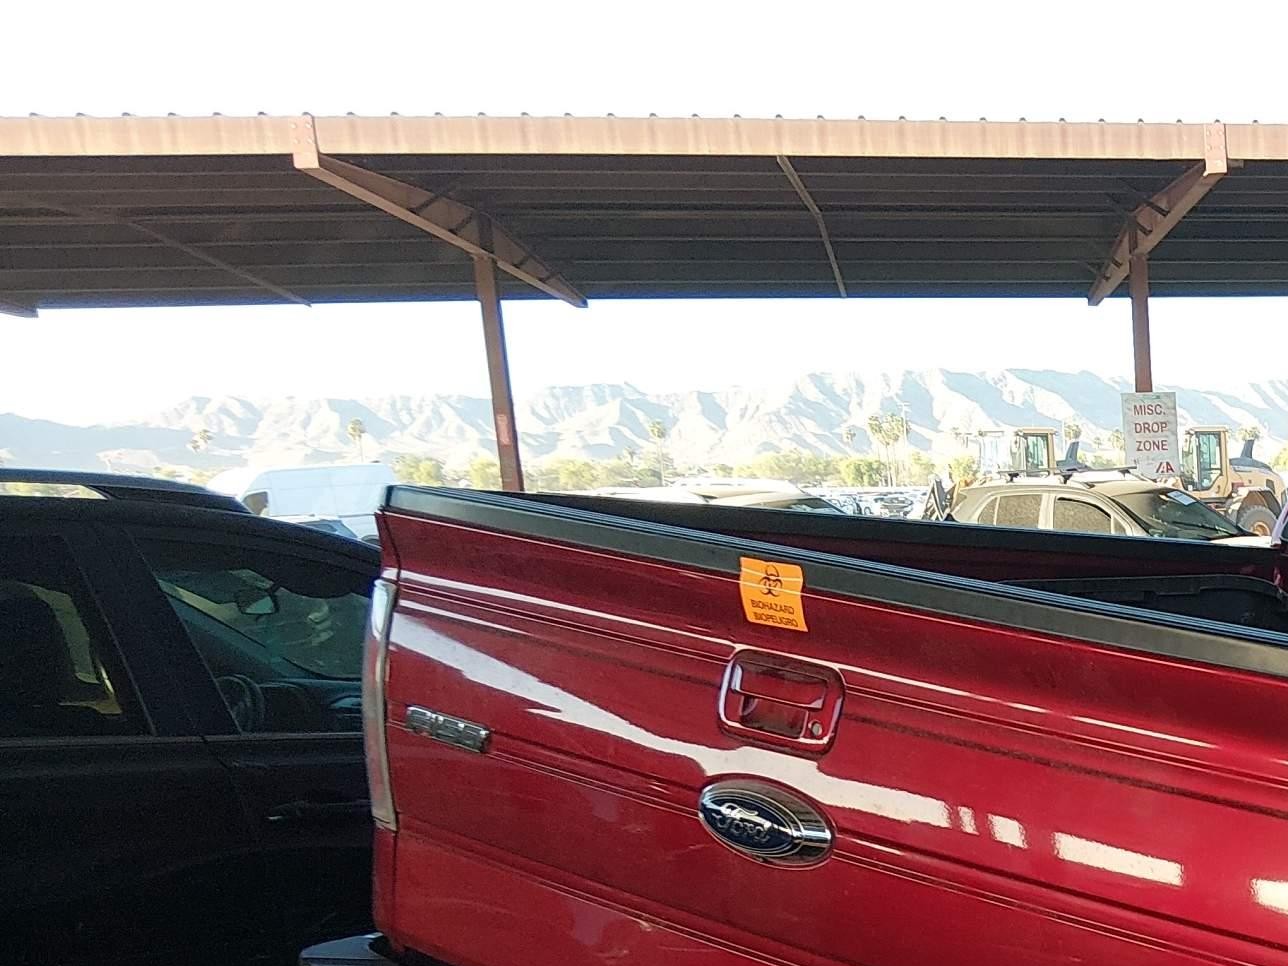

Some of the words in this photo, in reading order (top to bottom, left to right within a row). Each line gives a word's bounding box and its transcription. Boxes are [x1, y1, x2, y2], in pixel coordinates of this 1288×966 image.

[1133, 403, 1166, 416] MISC.
[1134, 421, 1168, 433] DROP
[1135, 440, 1169, 452] ZONE
[750, 599, 795, 615] BIOHAZARD
[711, 802, 773, 842] Ford
